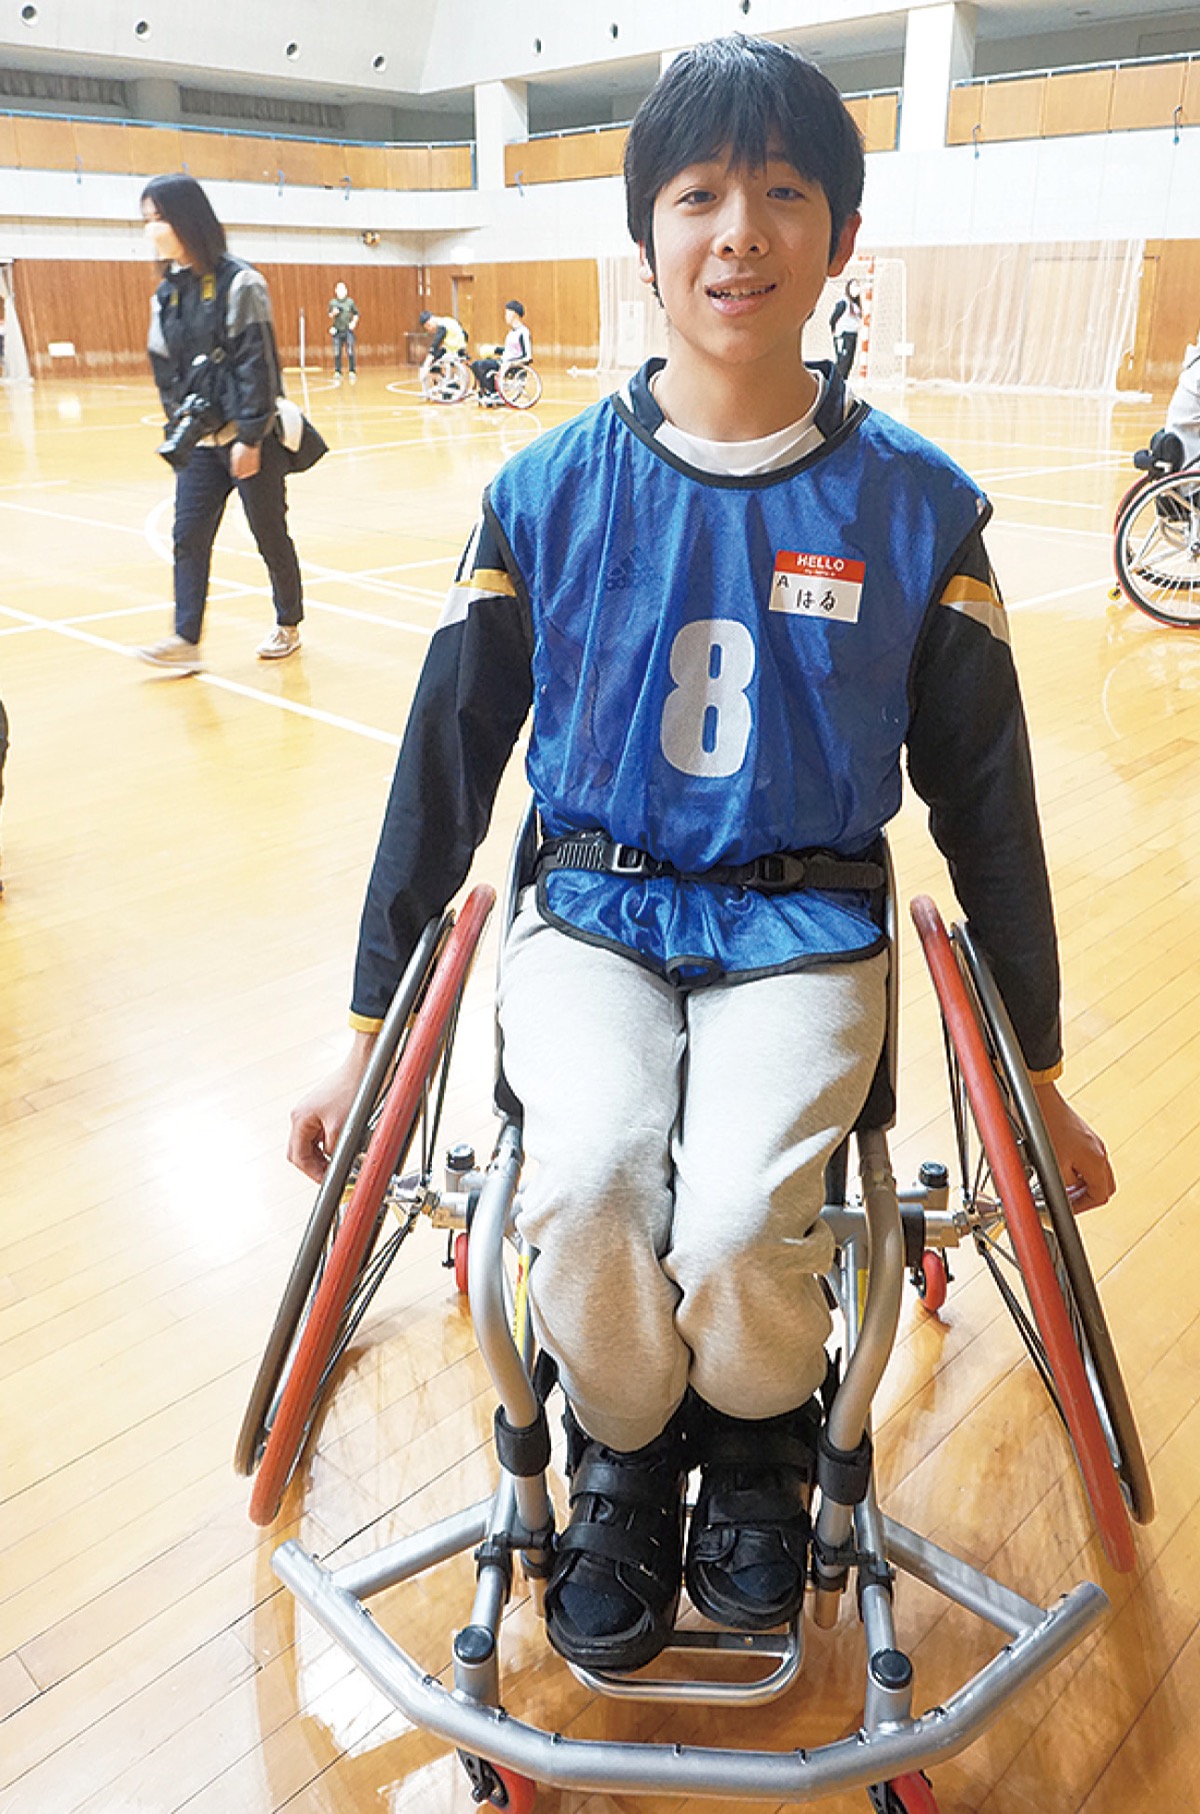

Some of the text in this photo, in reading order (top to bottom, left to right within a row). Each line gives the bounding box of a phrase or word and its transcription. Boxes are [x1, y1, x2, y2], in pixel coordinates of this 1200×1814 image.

[796, 554, 844, 572] HELLO
[777, 575, 789, 588] A
[796, 589, 836, 612] はる
[661, 619, 756, 778] 8
